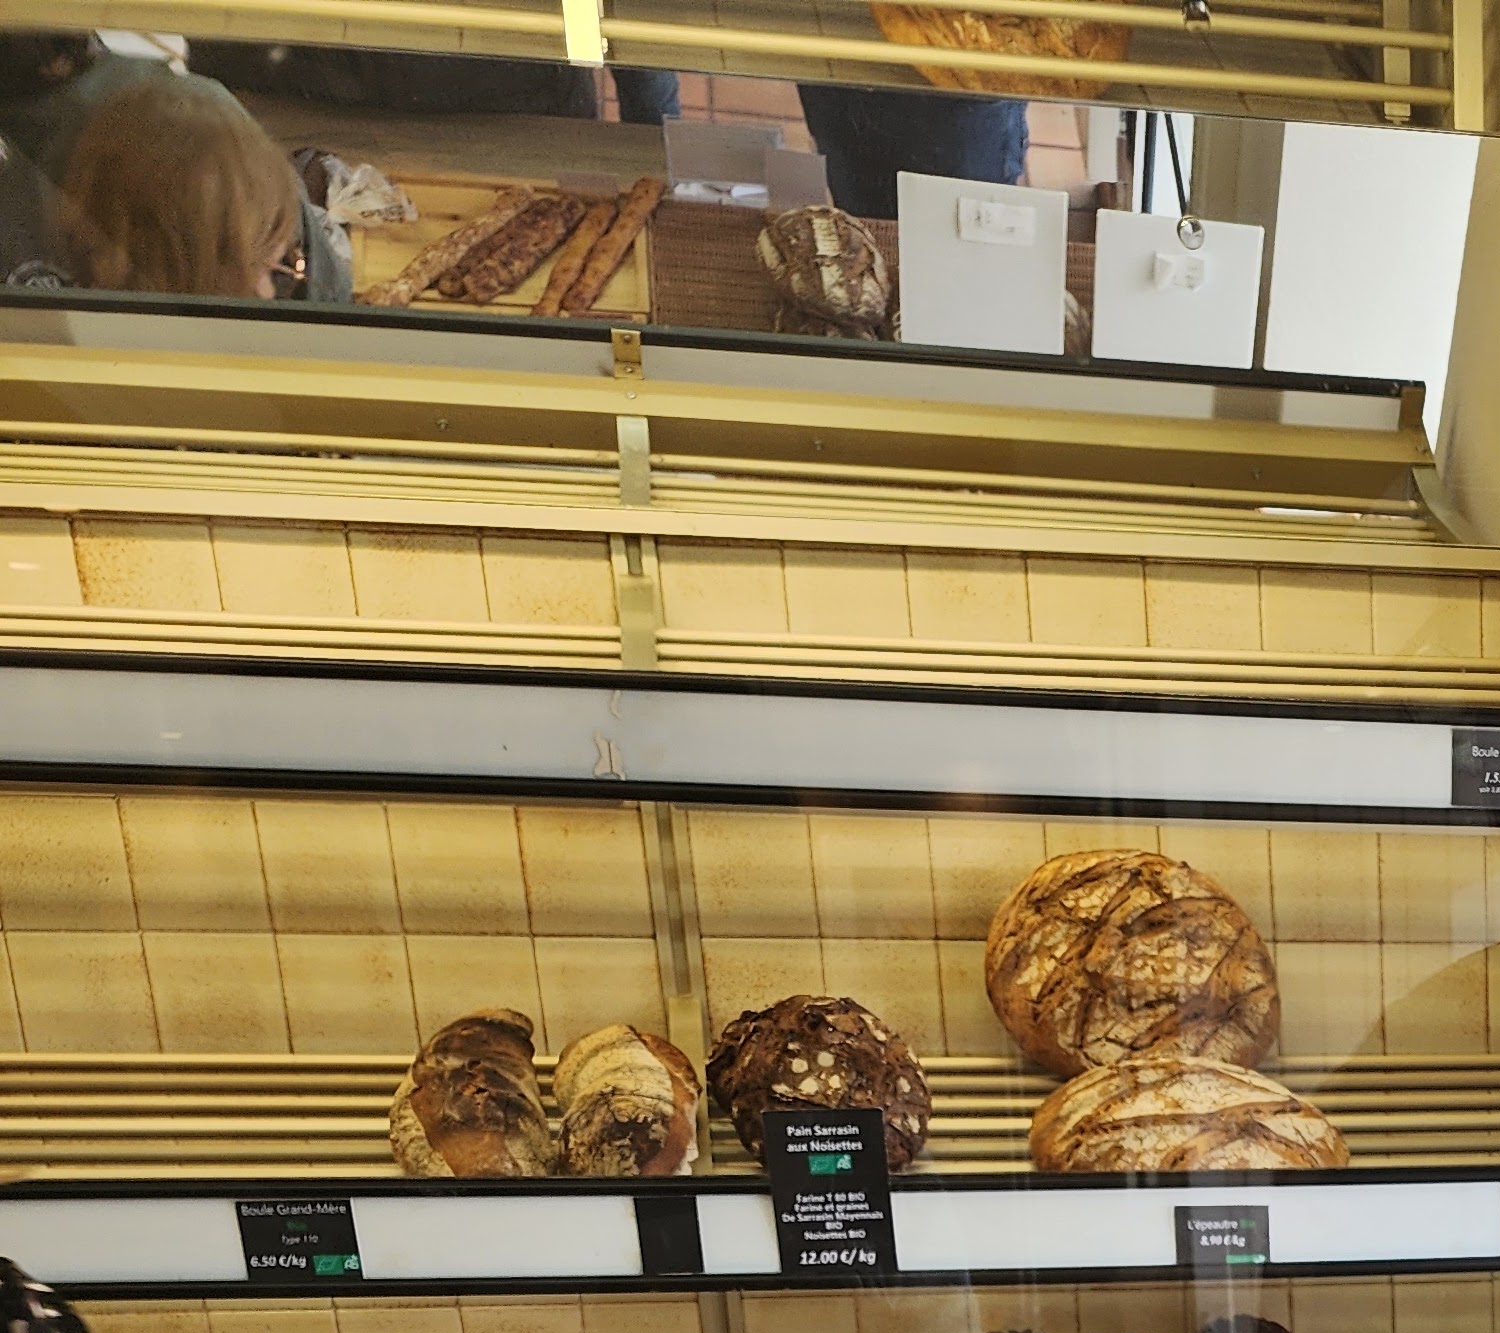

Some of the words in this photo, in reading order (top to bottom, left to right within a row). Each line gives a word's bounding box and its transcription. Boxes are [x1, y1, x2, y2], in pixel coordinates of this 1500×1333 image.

[1472, 745, 1499, 758] Boule
[786, 1125, 812, 1137] Pain
[813, 1124, 860, 1137] Sarrasin
[786, 1142, 808, 1153] aux
[810, 1140, 863, 1152] Noisettes
[241, 1203, 274, 1216] Boule
[799, 1251, 838, 1266] 12.00
